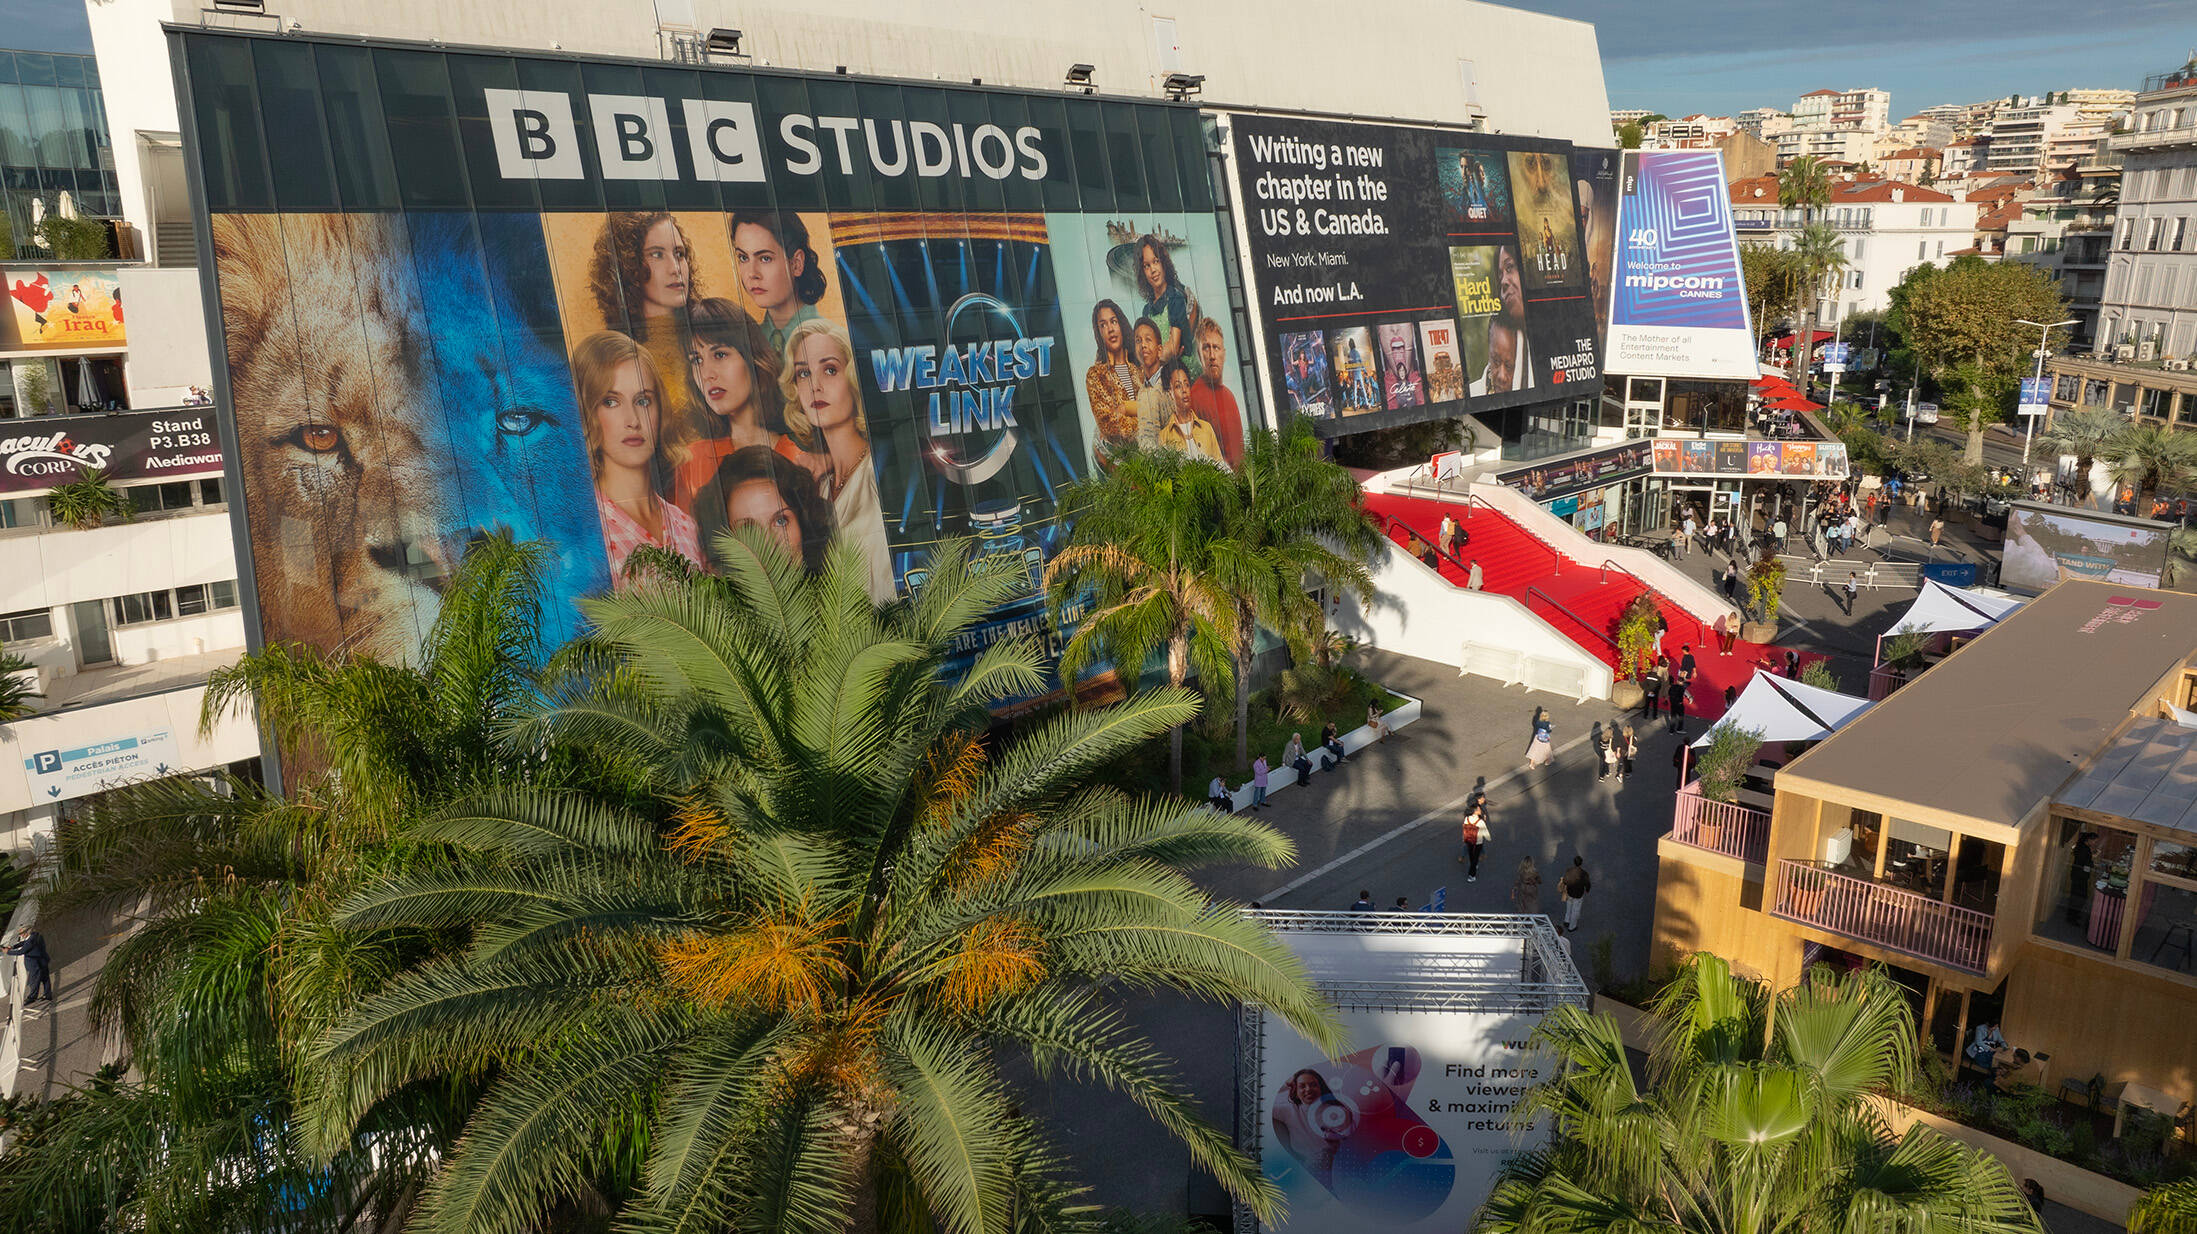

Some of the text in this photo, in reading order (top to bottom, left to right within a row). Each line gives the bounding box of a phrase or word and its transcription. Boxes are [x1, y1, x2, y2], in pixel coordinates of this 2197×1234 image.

[779, 113, 1048, 181] STUDIOS
[1248, 134, 1383, 170] Writing a new
[1256, 171, 1388, 205] chapter in the
[1626, 175, 1634, 192] mip
[1260, 208, 1389, 236] US & Canada.
[1628, 229, 1657, 246] 40
[1266, 251, 1349, 268] New York. Miami.
[1536, 253, 1567, 271] HEAD
[1627, 261, 1681, 270] Welcome to
[1456, 276, 1491, 296] Hard
[1625, 273, 1724, 291] mipcom
[1273, 282, 1364, 305] And now L.A.
[1679, 290, 1722, 299] CANNES
[1459, 294, 1502, 314] Truths
[63, 319, 107, 334] Iraq
[1575, 338, 1593, 352] THE
[1622, 333, 1692, 344] The Mother of all
[1620, 343, 1679, 352] Entertainment
[870, 336, 1055, 393] WEAKEST
[1550, 352, 1594, 370] MEDIAPRO
[1619, 351, 1690, 362] Content Markets
[1565, 366, 1596, 382] STUDIO
[929, 385, 1018, 437] LINK
[152, 418, 203, 434] Stand
[150, 432, 211, 449] P3.B38
[19, 460, 75, 477] CORP.
[145, 451, 223, 470] Mediawan
[87, 743, 121, 756] Palais
[1445, 1064, 1538, 1079] Find more
[1466, 1083, 1530, 1096] viewer
[1428, 1099, 1522, 1113] & maximi
